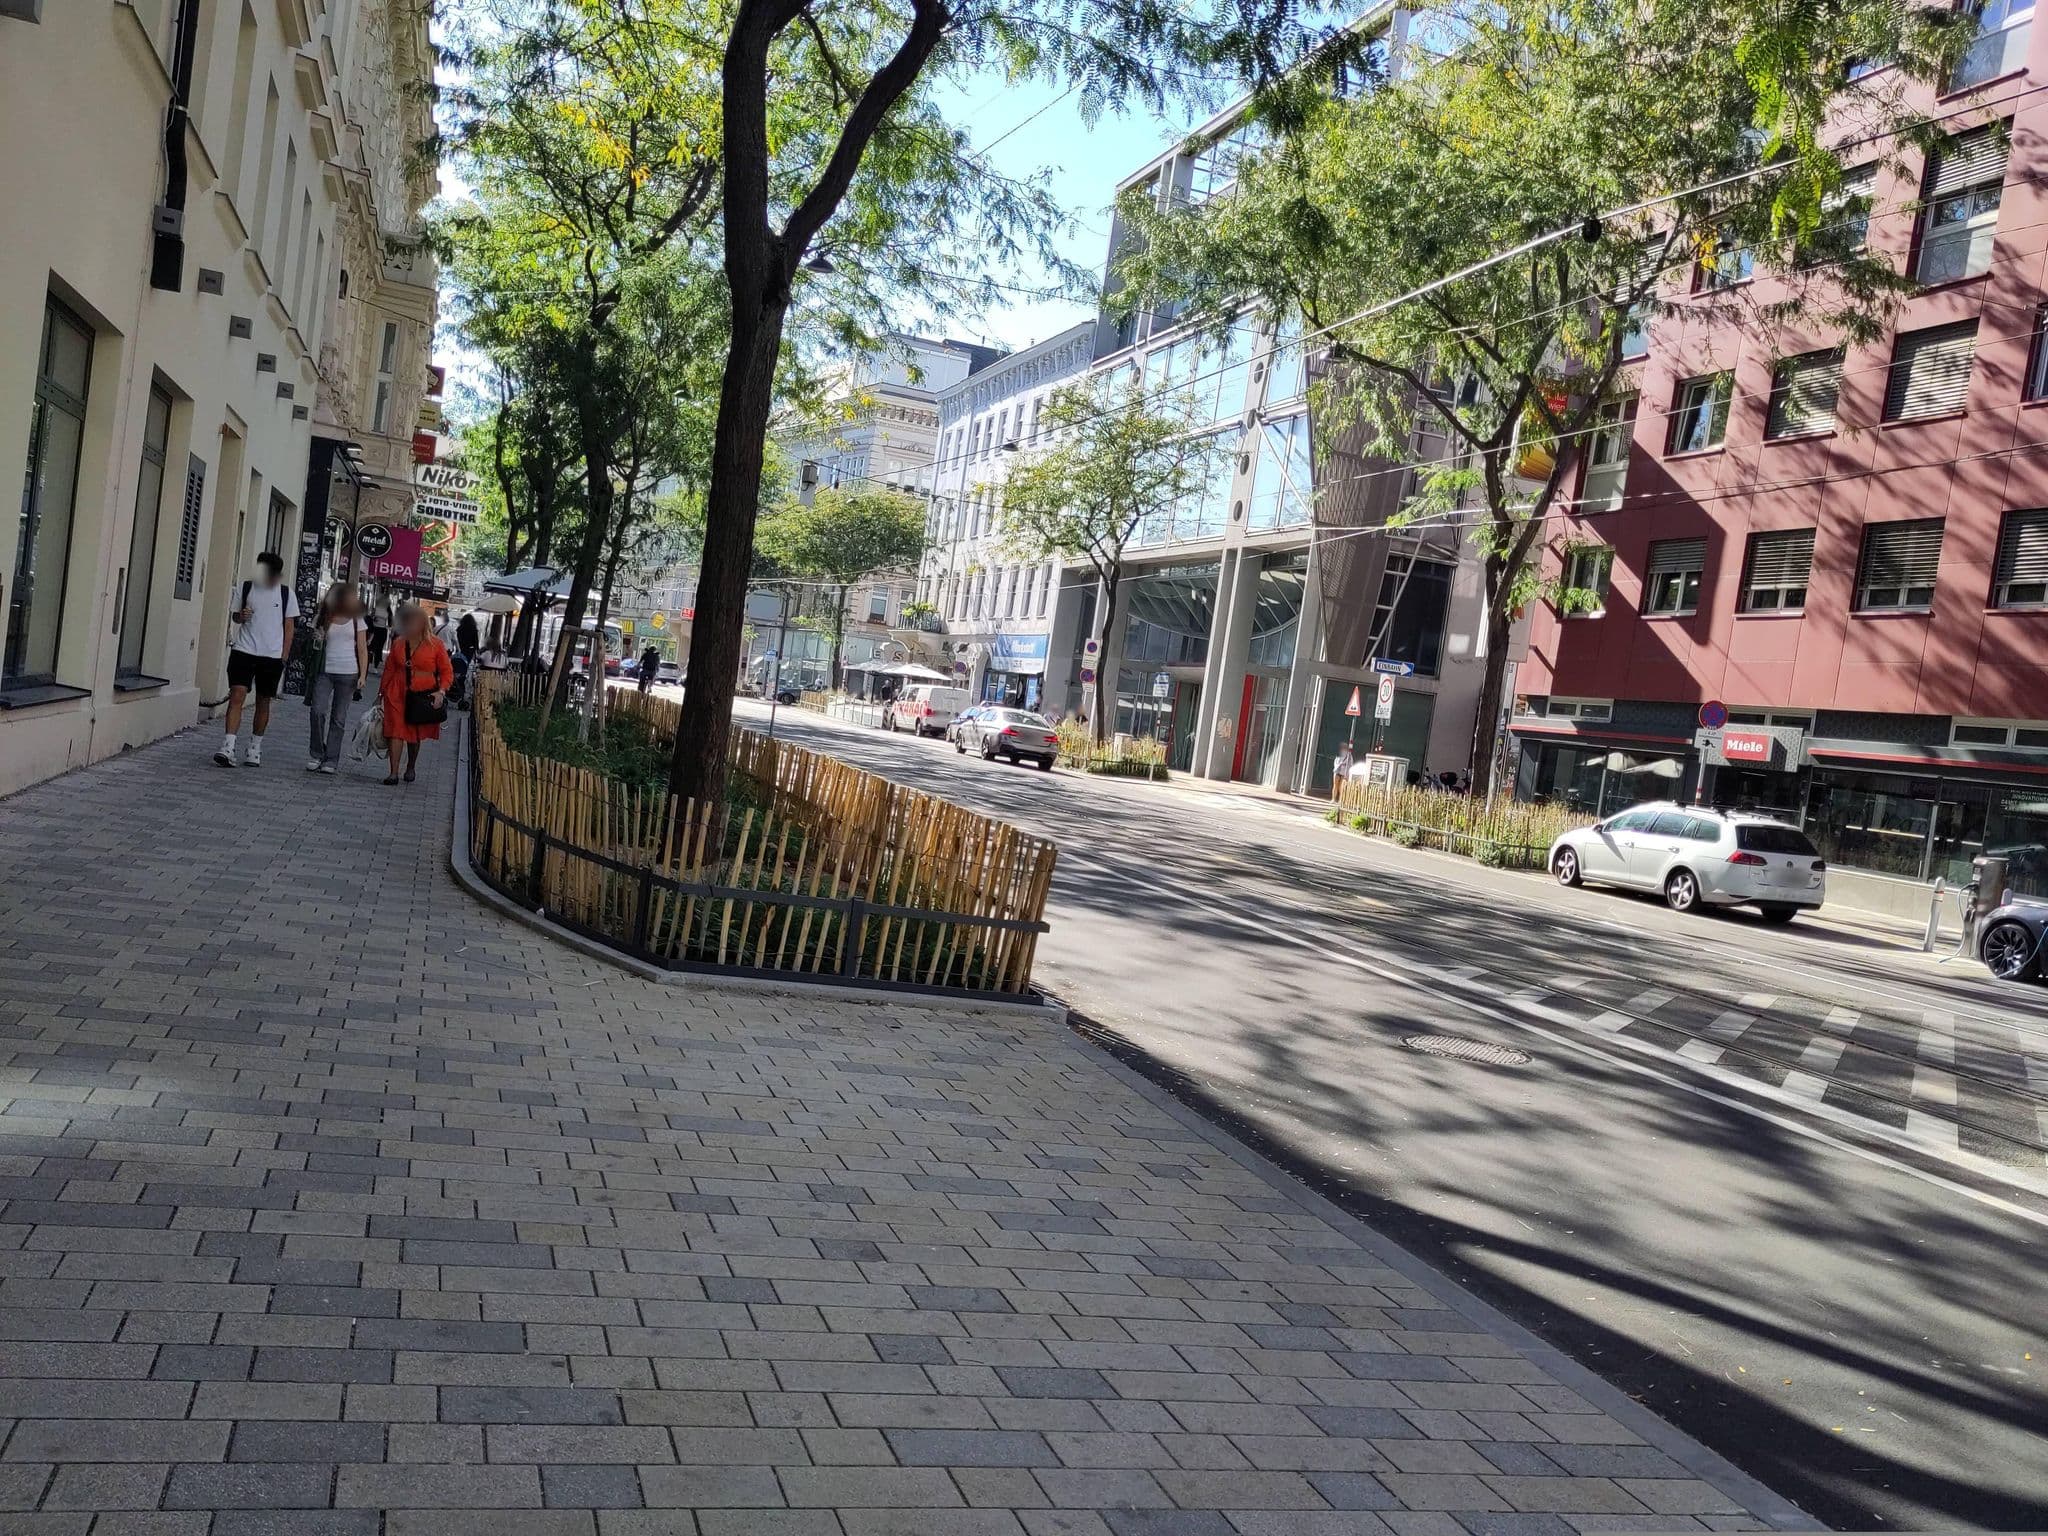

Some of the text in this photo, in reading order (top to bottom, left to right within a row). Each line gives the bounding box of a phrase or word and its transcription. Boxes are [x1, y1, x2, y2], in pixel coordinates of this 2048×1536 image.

[422, 467, 480, 488] Nikon
[379, 562, 413, 577] BIPA
[1726, 739, 1764, 752] Miele
